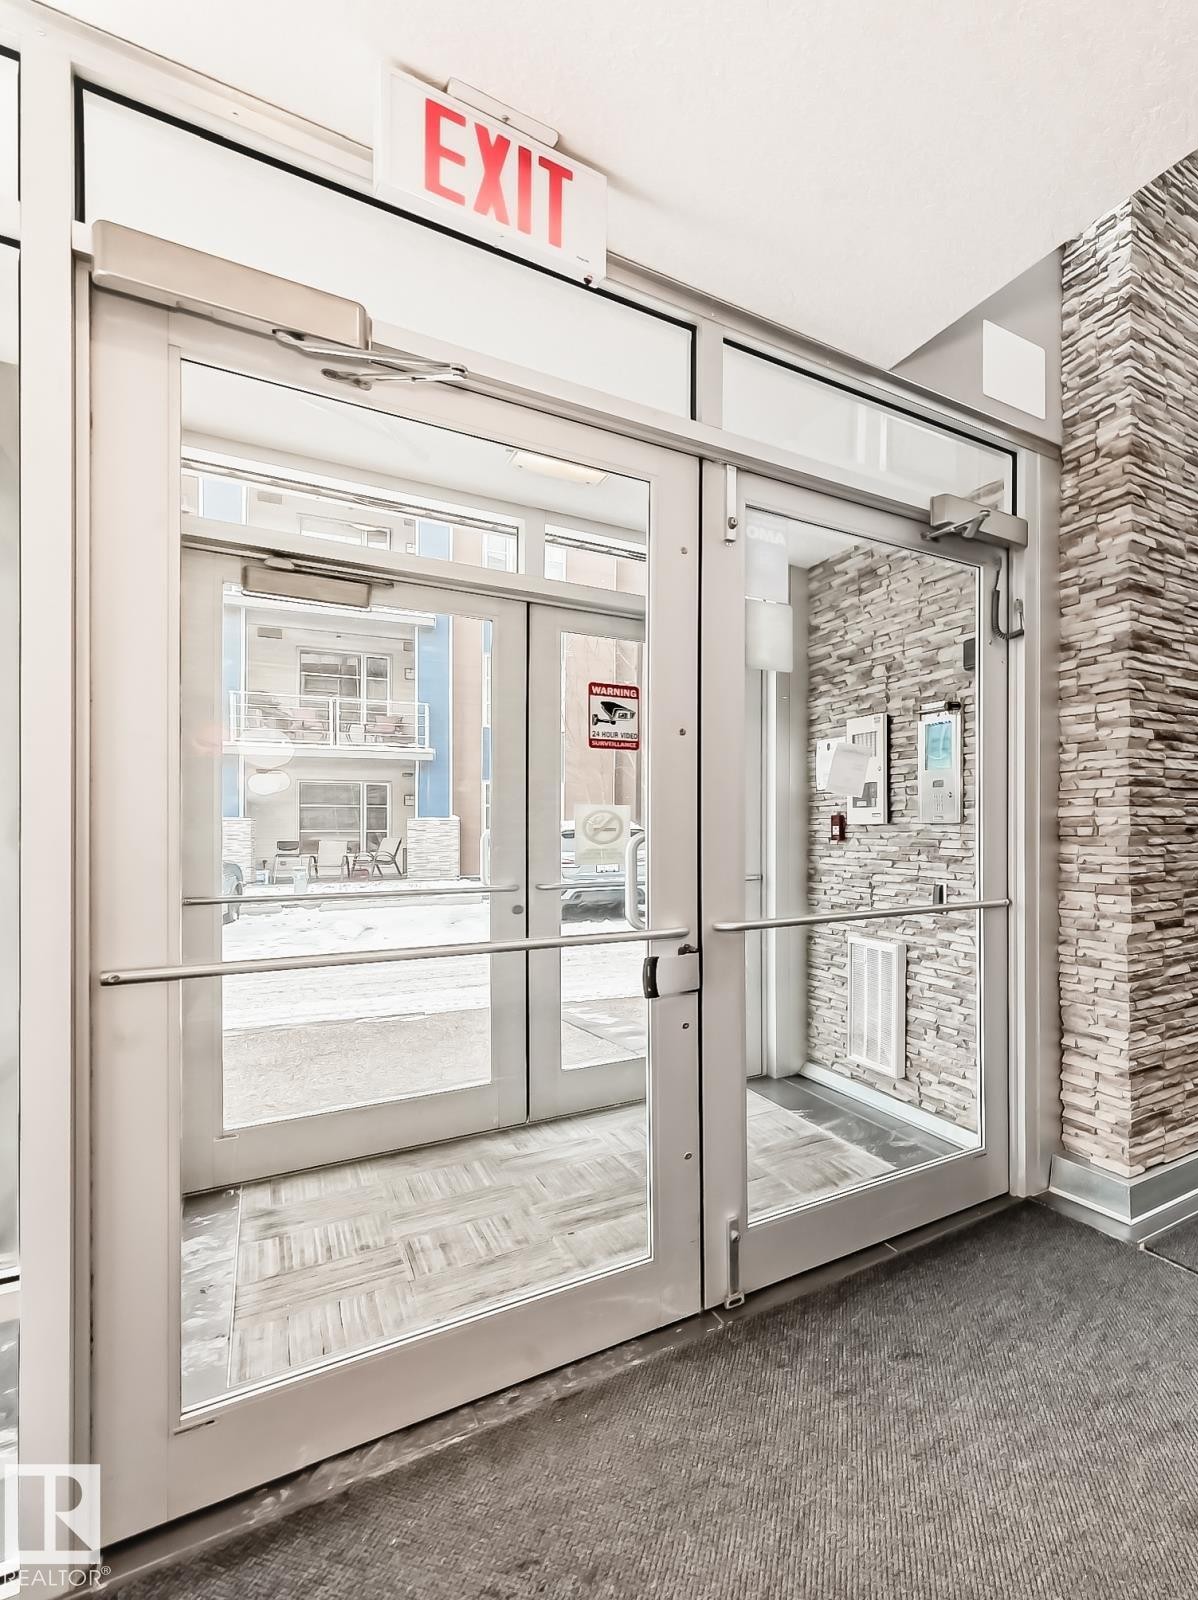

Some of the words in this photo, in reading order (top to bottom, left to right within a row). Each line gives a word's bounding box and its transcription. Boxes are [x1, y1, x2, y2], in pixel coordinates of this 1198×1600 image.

[425, 97, 573, 249] EXIT
[591, 685, 637, 698] WARNING
[592, 730, 600, 738] 24
[602, 731, 619, 739] HOUR
[620, 732, 638, 740] VIDEO
[591, 740, 637, 748] SURVEILLANCE
